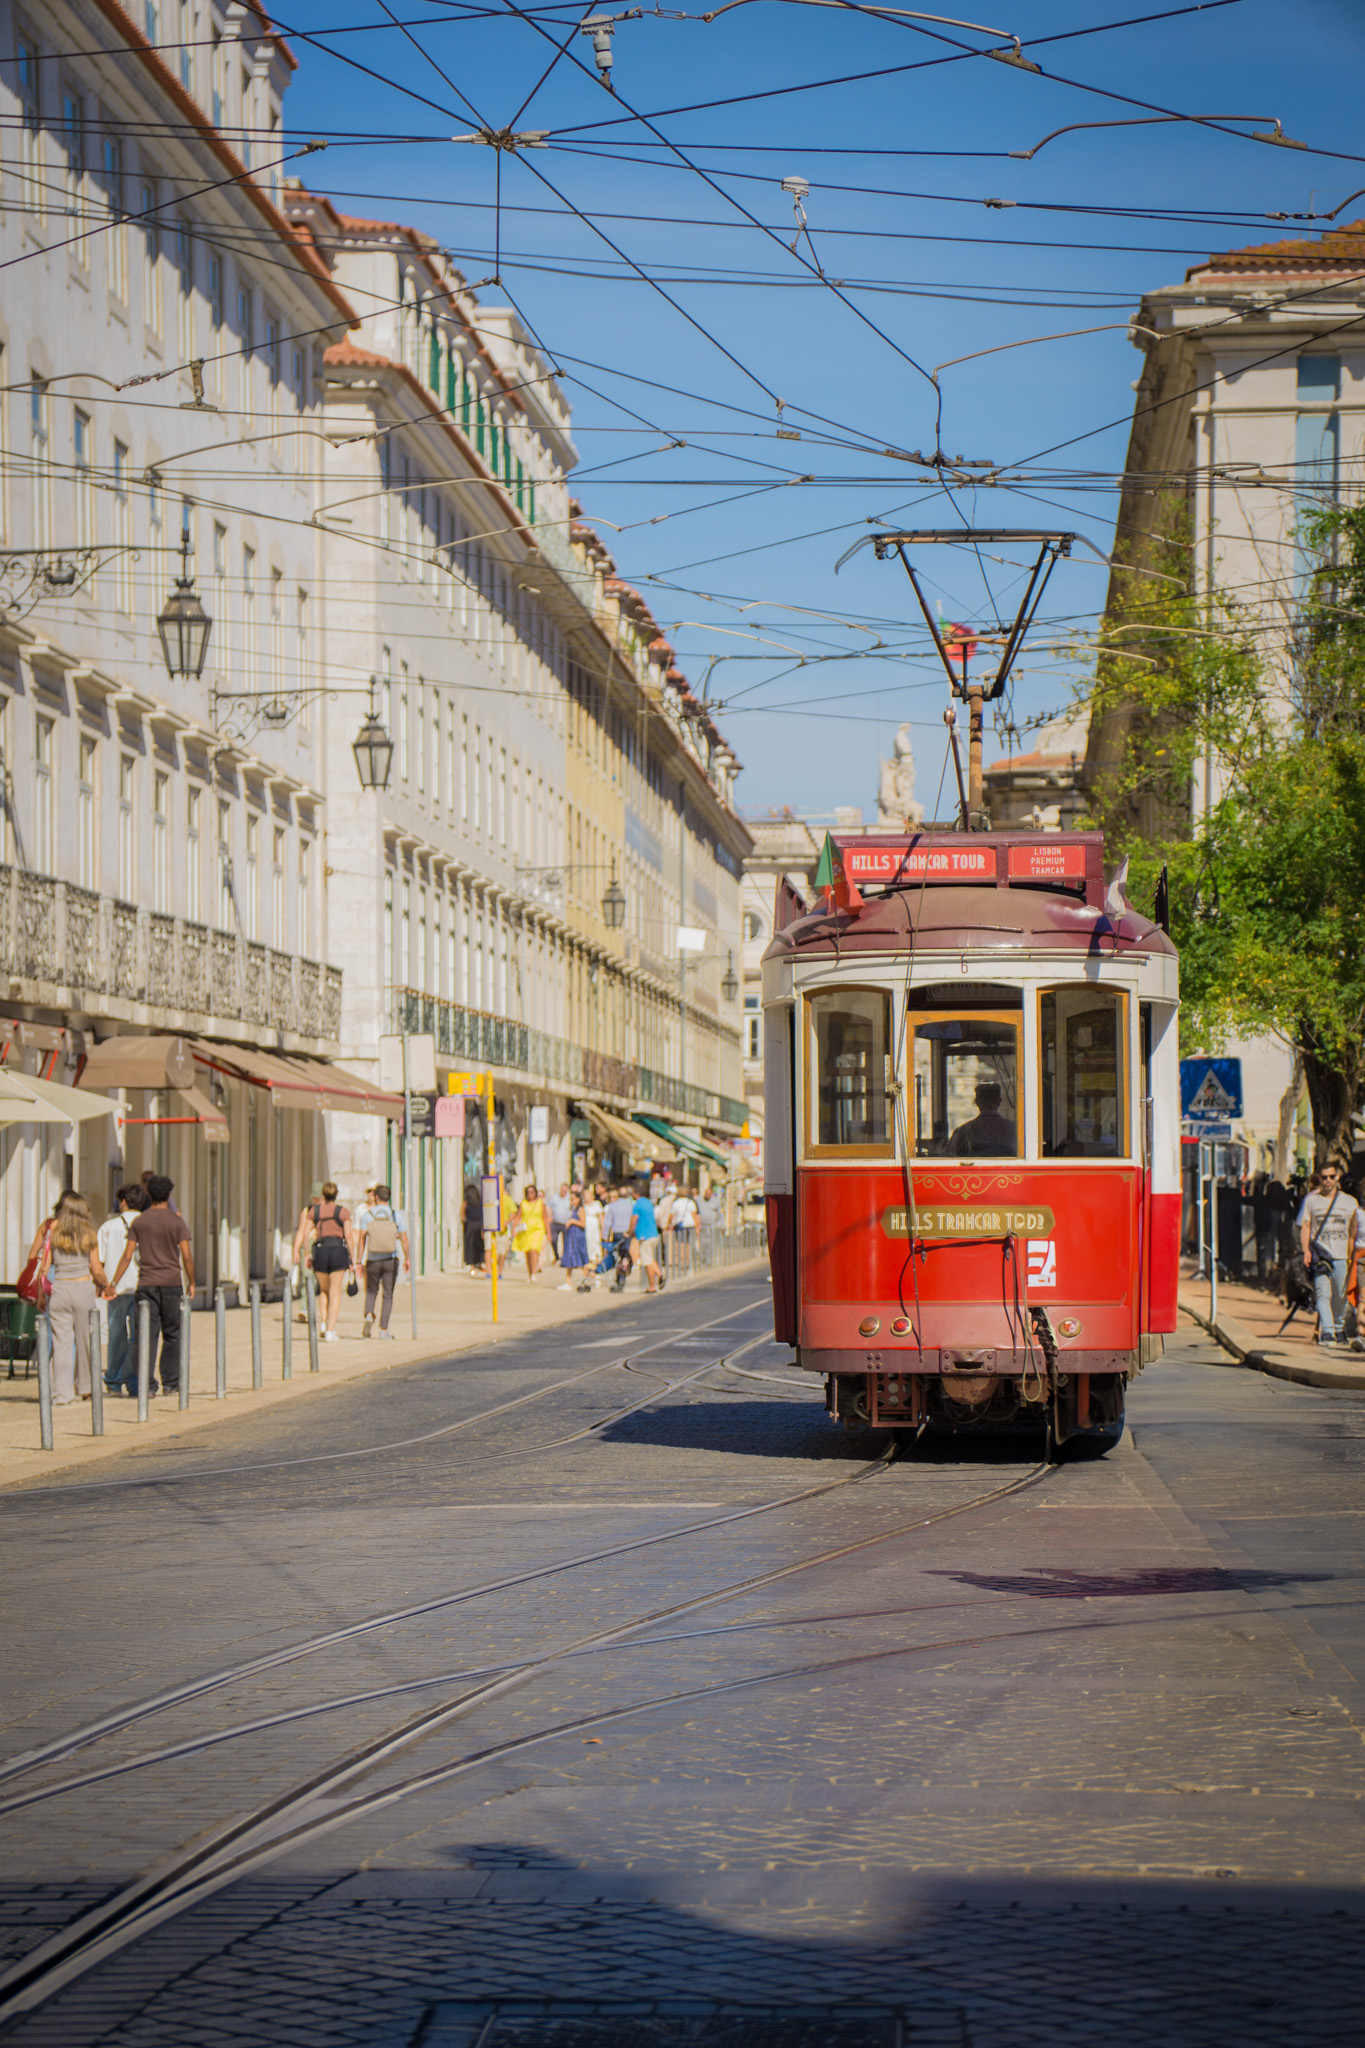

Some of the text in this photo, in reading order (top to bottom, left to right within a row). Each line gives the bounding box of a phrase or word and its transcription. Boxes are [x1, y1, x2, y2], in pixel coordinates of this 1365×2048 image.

[1034, 847, 1062, 855] LISBON
[852, 854, 985, 870] HILLS TRAMCAR TOUR
[1030, 856, 1065, 865] PREMIUM
[1031, 866, 1065, 875] TRAMCAR
[960, 959, 969, 974] 6
[890, 1212, 934, 1231] HILLS
[937, 1212, 1002, 1231] TRAMCAR
